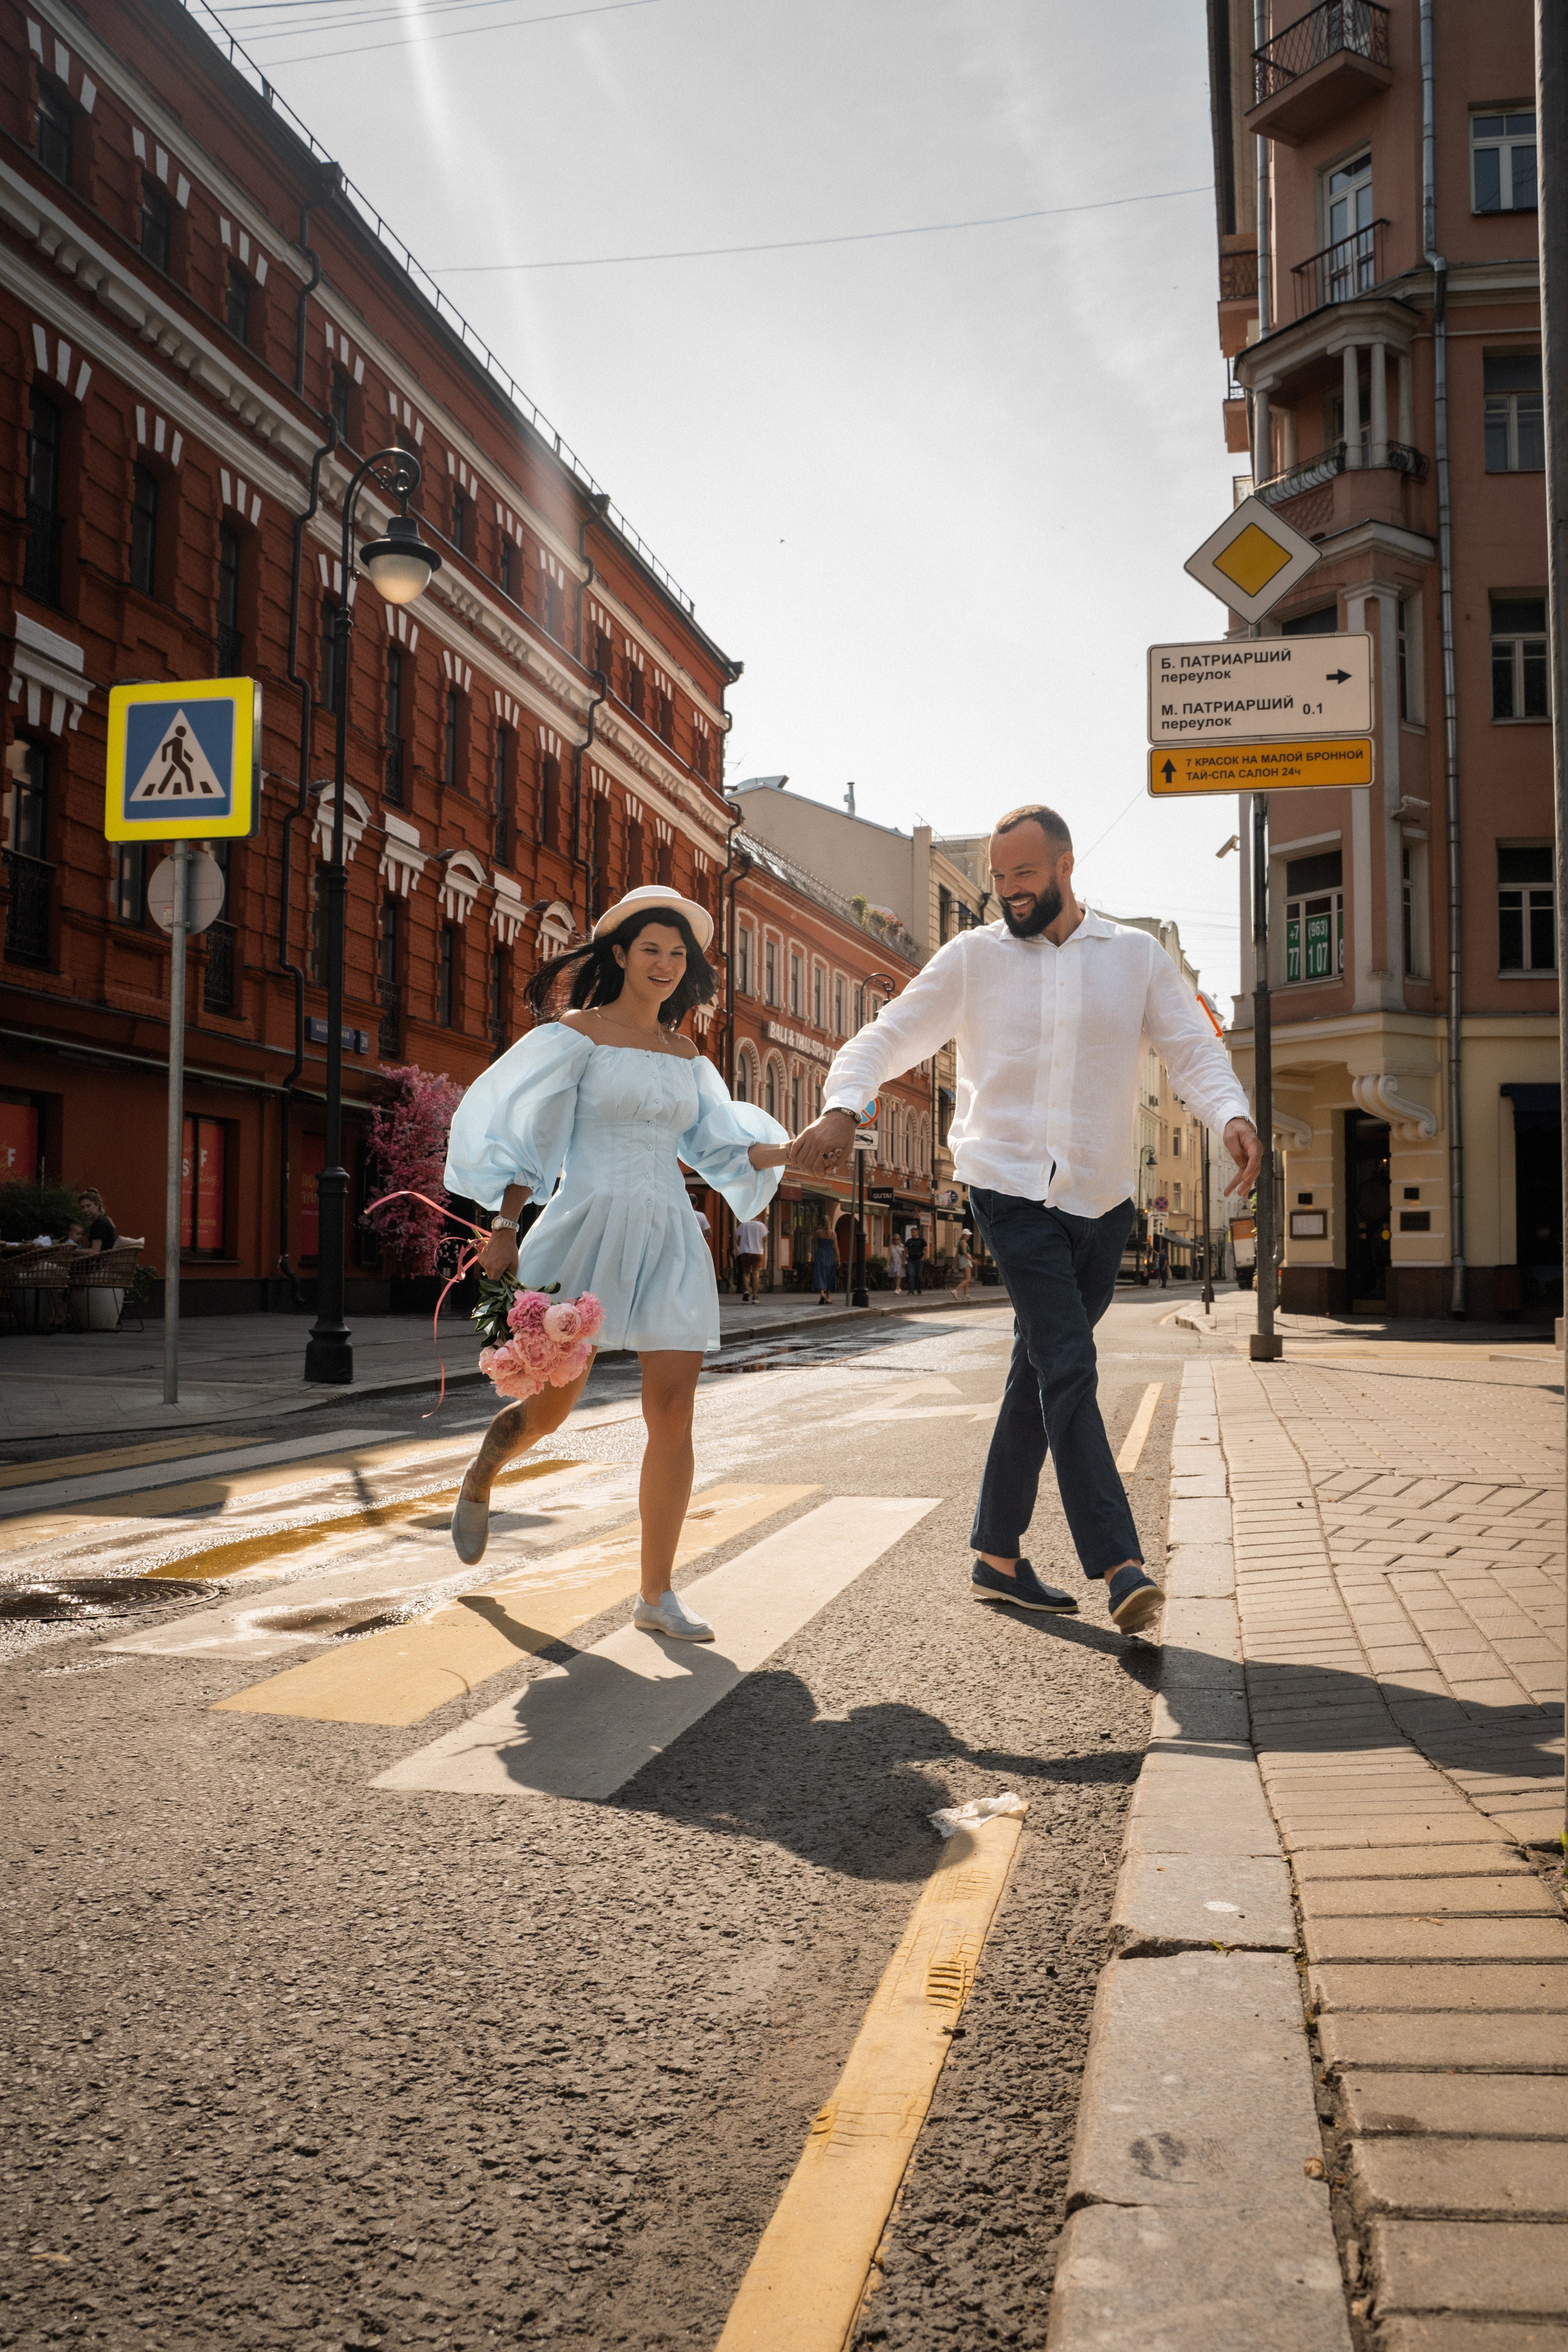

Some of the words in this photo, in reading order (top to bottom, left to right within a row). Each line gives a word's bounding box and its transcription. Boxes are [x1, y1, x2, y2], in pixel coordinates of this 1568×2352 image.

[1161, 658, 1175, 669] Б.
[1181, 647, 1291, 668] ПАТРИАРШИЙ
[1161, 670, 1232, 684] переулок
[1161, 704, 1177, 715] М.
[1183, 695, 1294, 715] ПАТРИАРШИЙ
[1303, 703, 1323, 715] 0.1
[1161, 717, 1232, 731] переулок
[1195, 756, 1239, 766] КРАСОК
[1242, 755, 1257, 764] НА
[1261, 751, 1303, 763] МАЛОЙ
[1306, 748, 1363, 761] БРОННОЙ
[1186, 768, 1235, 780] ТАЙ-СПА
[1239, 767, 1279, 779] САЛОН
[1282, 767, 1301, 776] 24ч
[1289, 925, 1300, 940] +7
[1308, 919, 1328, 941] (963)
[769, 1021, 788, 1044] BALI
[788, 1029, 794, 1047] &
